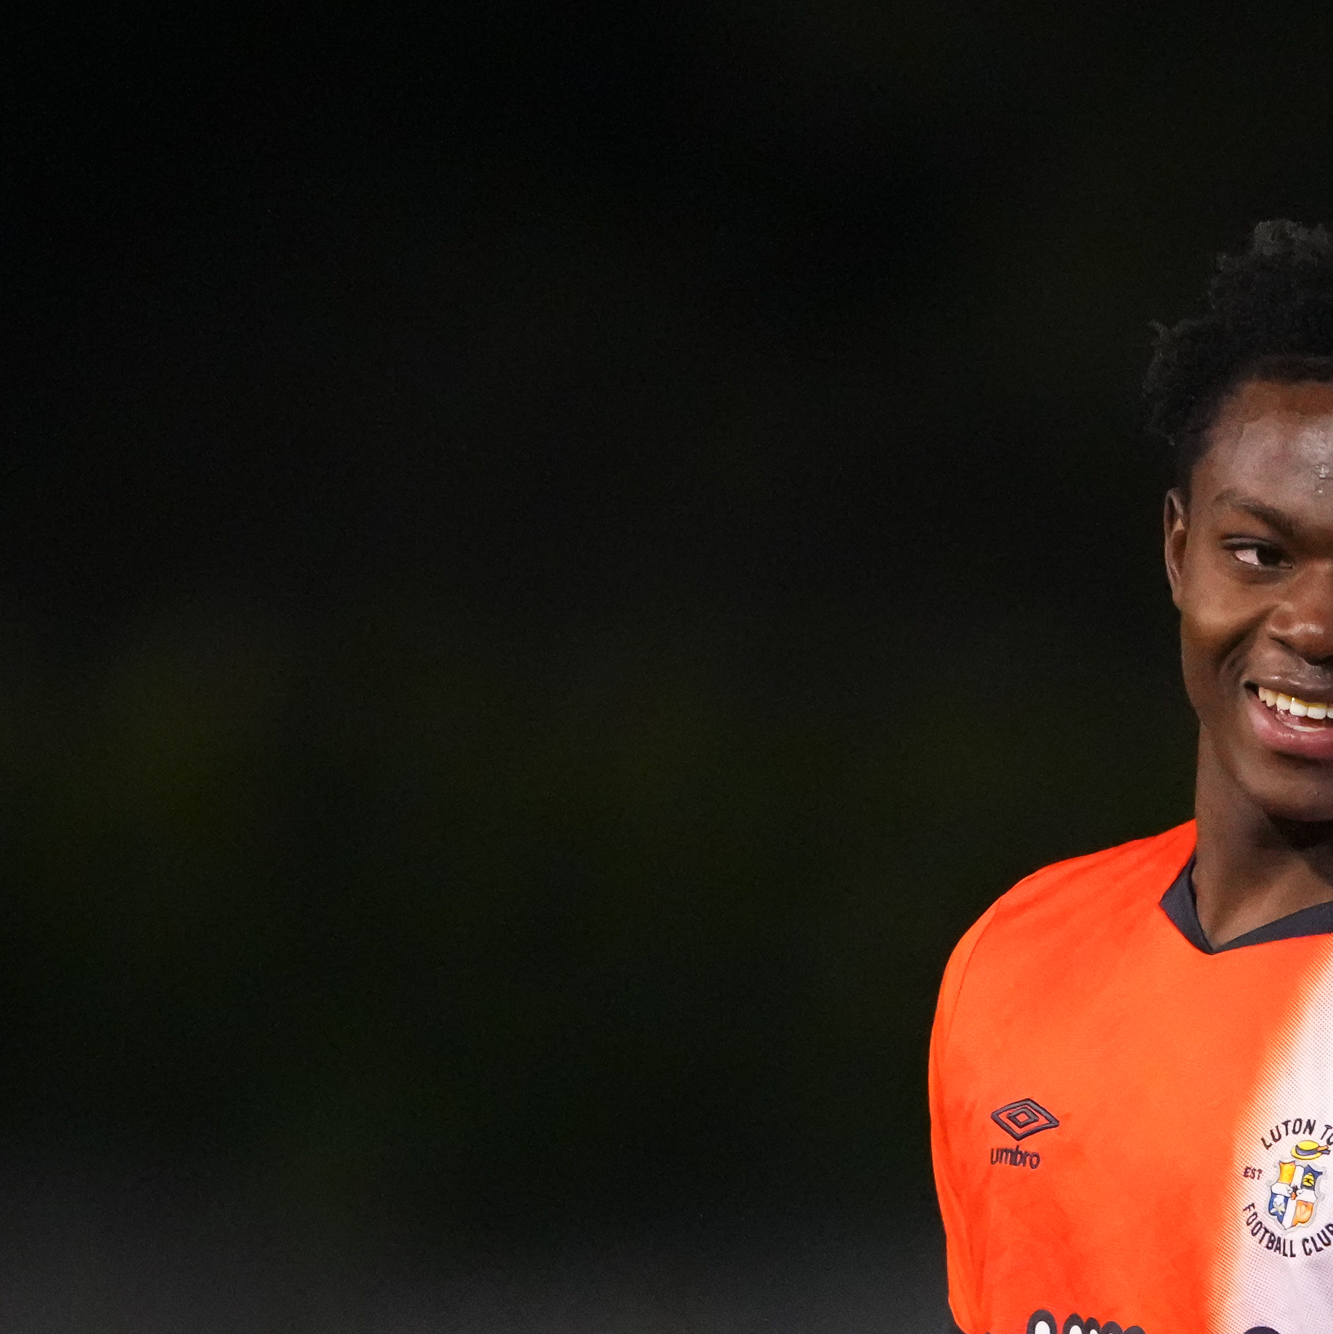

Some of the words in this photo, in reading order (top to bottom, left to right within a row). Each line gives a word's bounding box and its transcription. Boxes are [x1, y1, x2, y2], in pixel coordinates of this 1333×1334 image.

[1260, 1118, 1317, 1151] LUTON
[989, 1145, 1041, 1170] umbro
[1242, 1165, 1263, 1180] EST
[1242, 1202, 1297, 1258] FOOTBALL
